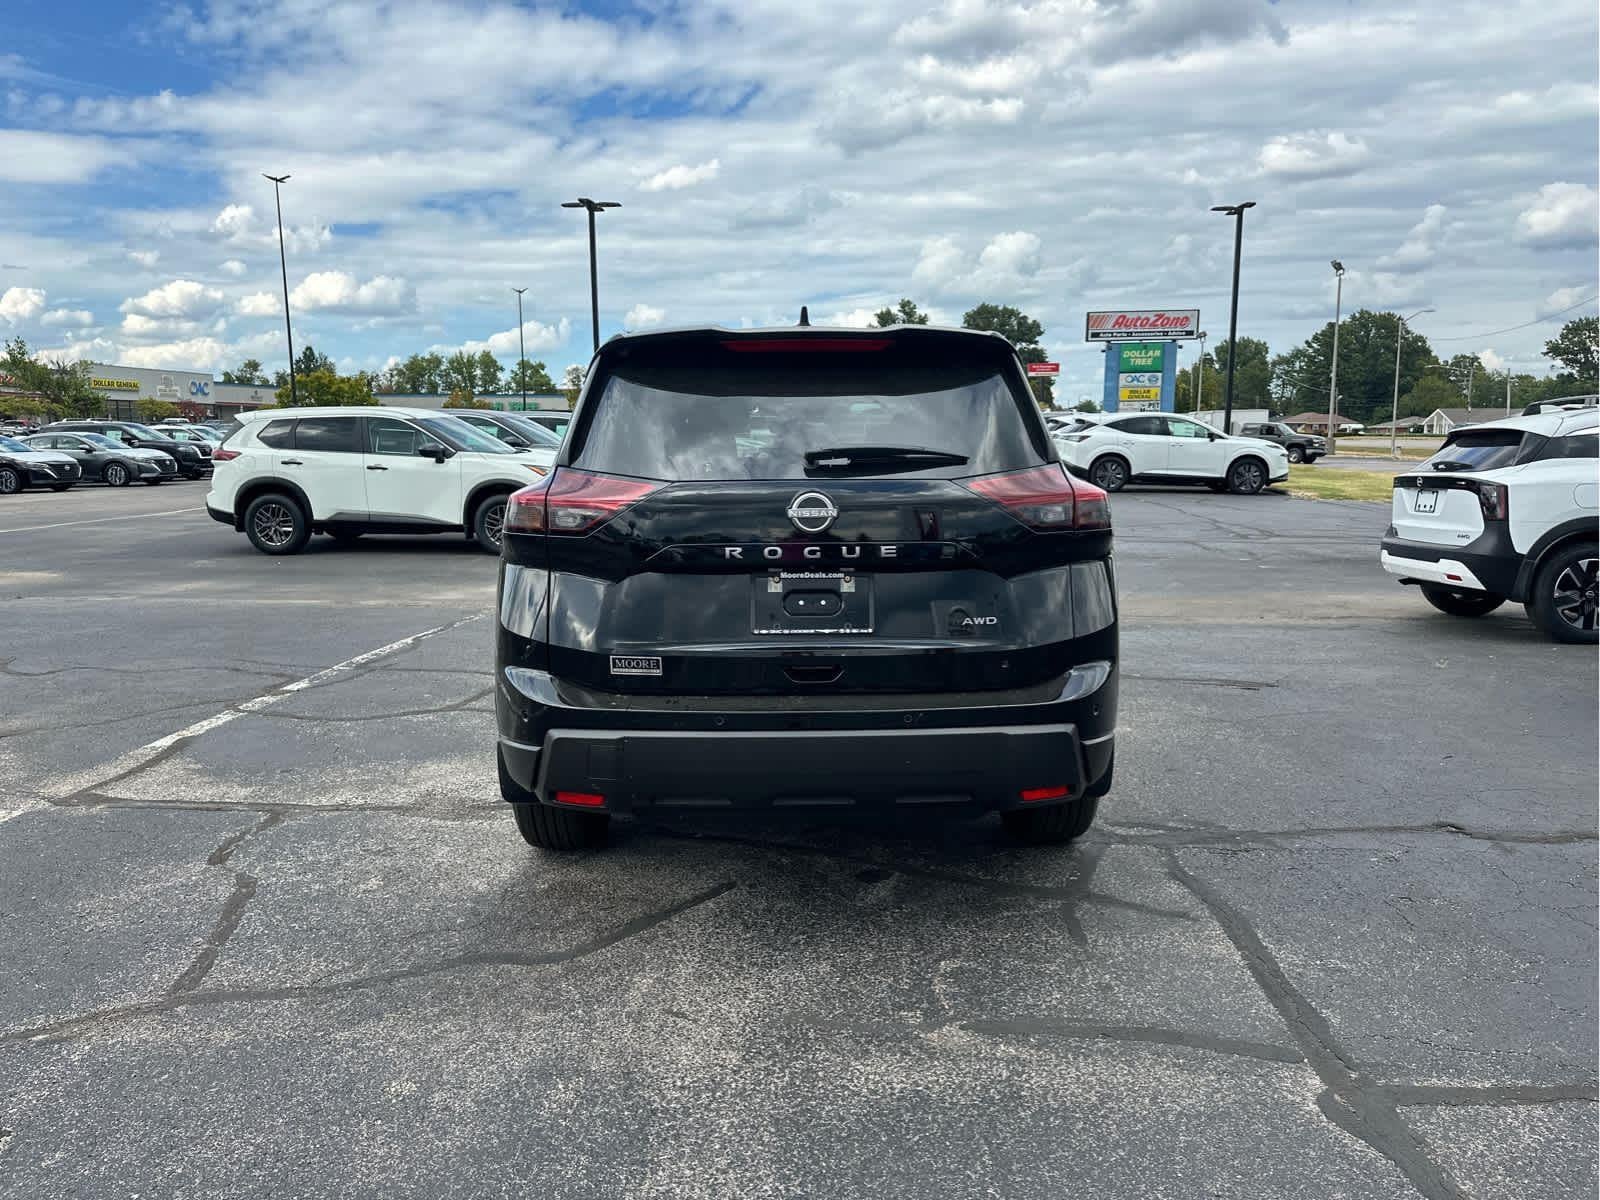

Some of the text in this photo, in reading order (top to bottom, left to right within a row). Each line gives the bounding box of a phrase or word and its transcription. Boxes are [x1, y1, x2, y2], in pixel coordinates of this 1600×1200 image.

[1113, 313, 1190, 329] AutoZone
[1123, 350, 1160, 358] DOLLAR
[93, 379, 139, 389] DOLLAR GENERAL
[787, 509, 838, 518] NISSAN
[724, 545, 898, 560] ROGUE
[961, 616, 998, 626] AWD
[615, 659, 658, 669] MOORE
